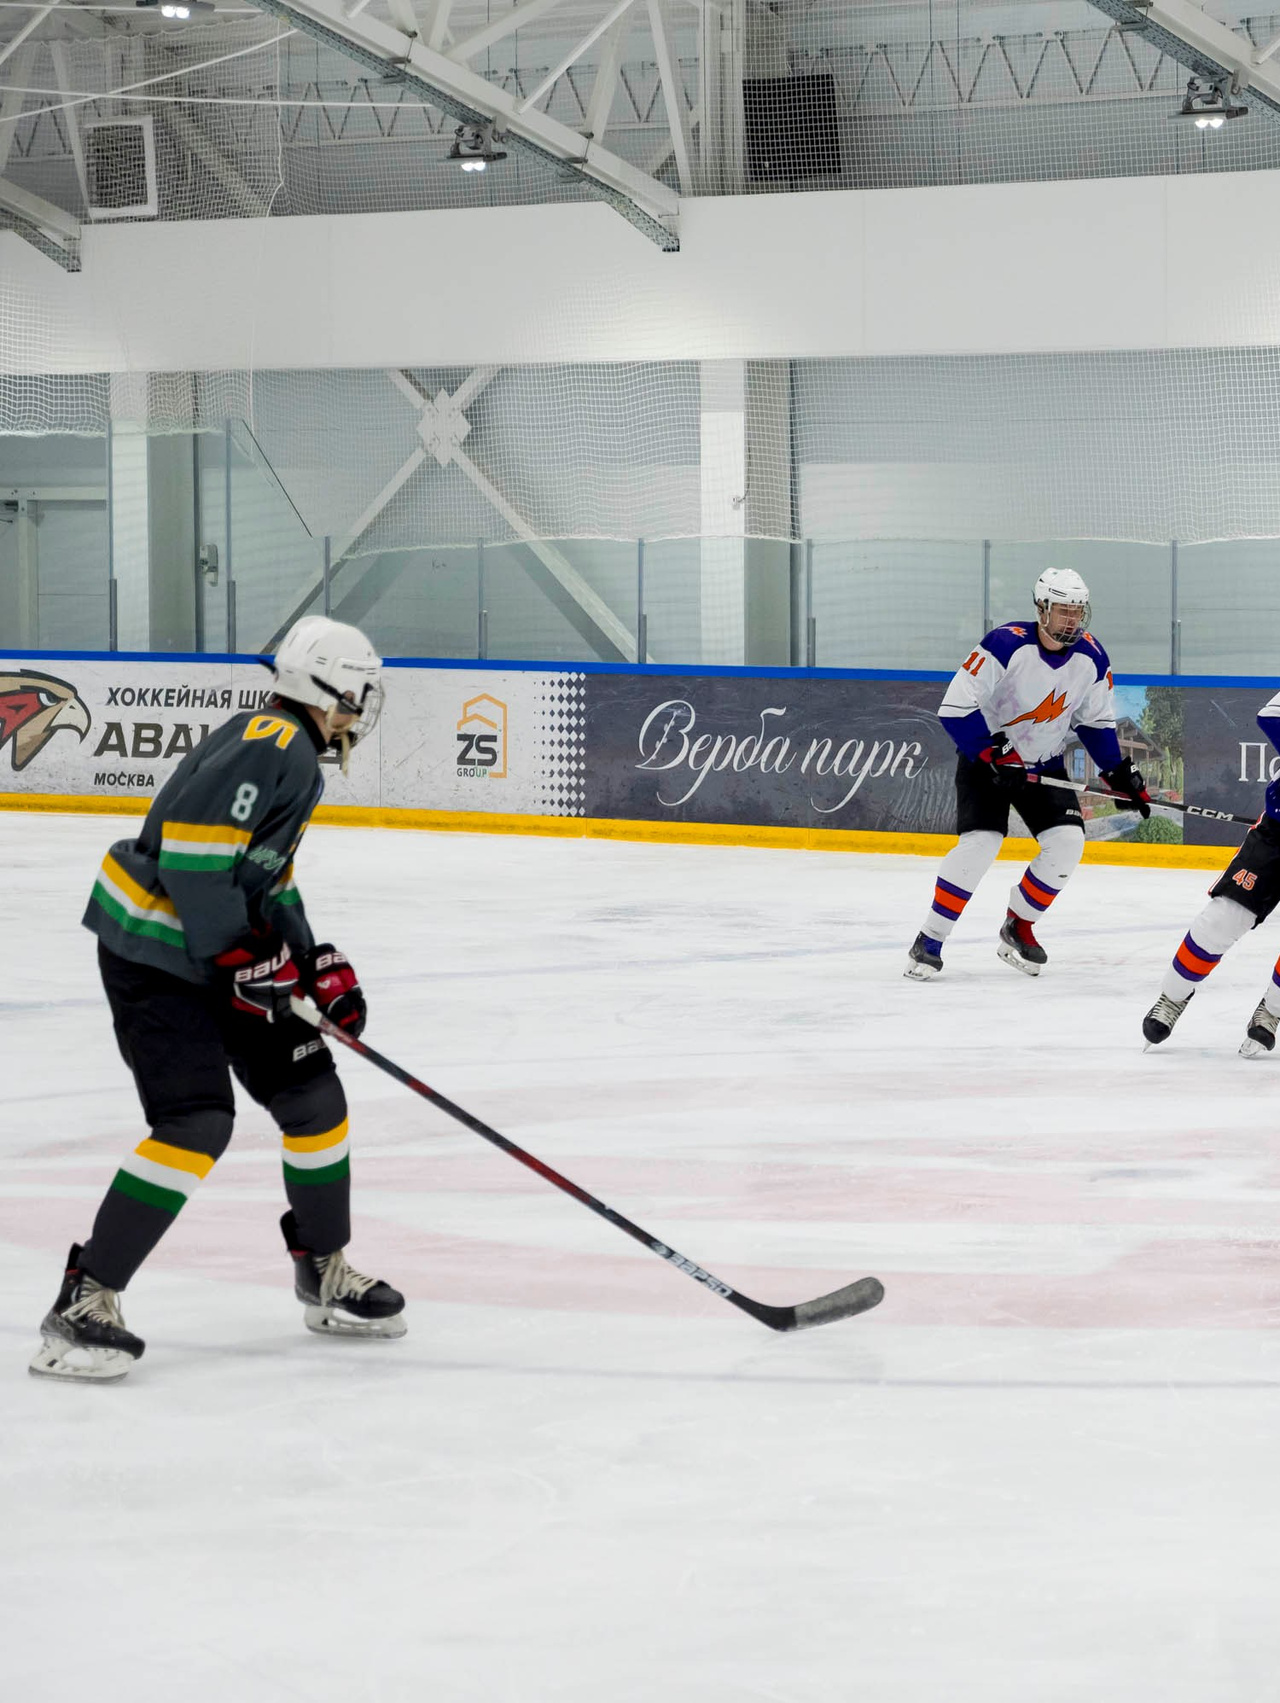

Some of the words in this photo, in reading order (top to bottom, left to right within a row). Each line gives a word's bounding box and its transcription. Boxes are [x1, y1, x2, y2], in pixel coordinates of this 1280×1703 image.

[107, 684, 232, 710] ХОККЕЙНАЯ
[237, 689, 273, 710] ШК
[456, 733, 498, 767] ZS
[634, 699, 798, 807] Верба
[799, 737, 929, 814] парк
[94, 772, 155, 788] МОСКВА
[456, 767, 488, 778] GROUP
[230, 782, 259, 822] 8
[1187, 805, 1234, 822] CCM
[1231, 868, 1259, 892] 45
